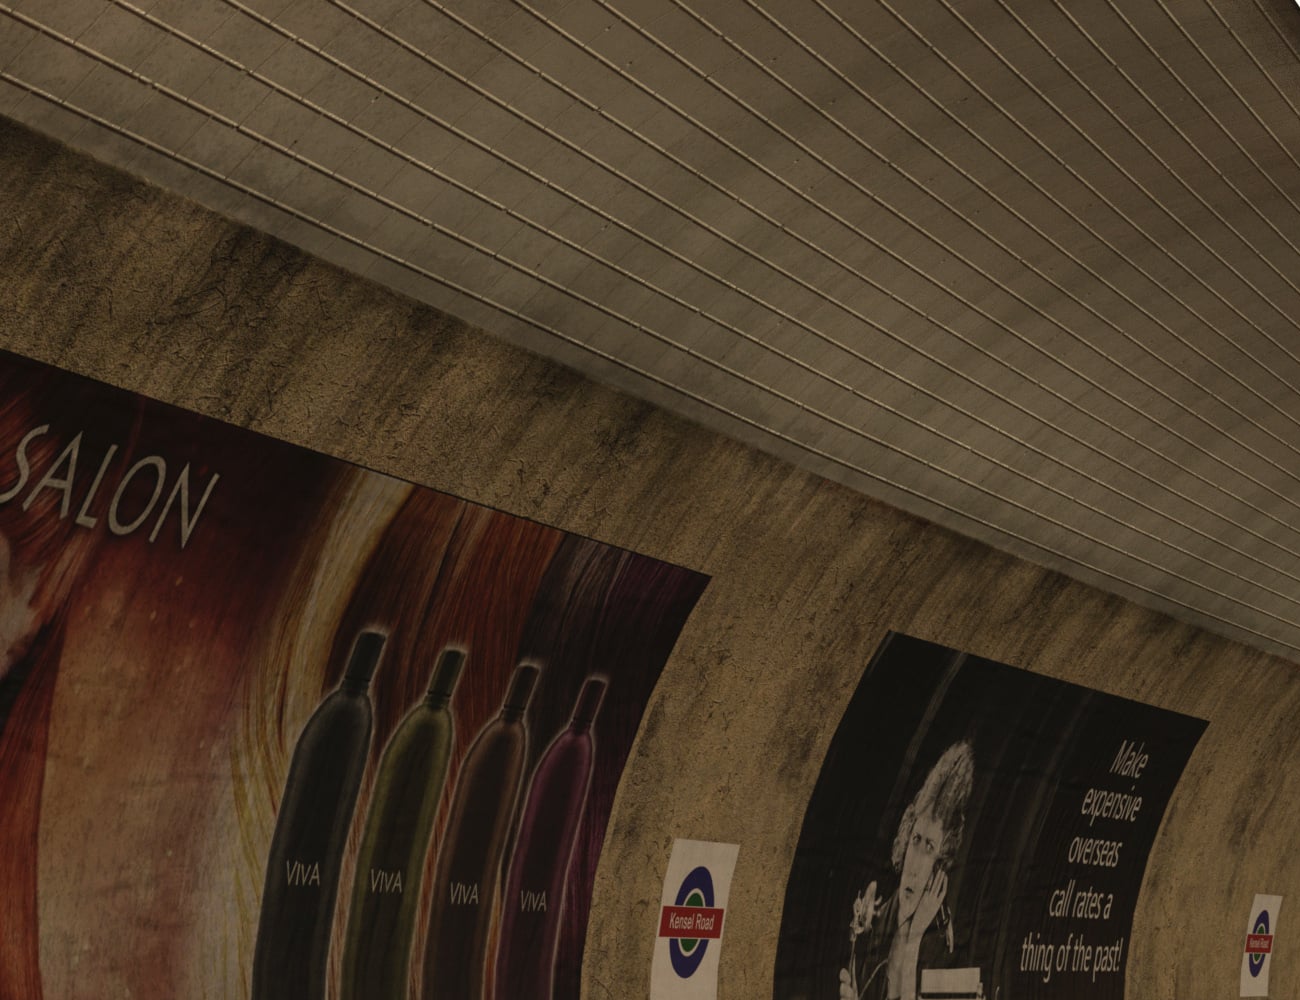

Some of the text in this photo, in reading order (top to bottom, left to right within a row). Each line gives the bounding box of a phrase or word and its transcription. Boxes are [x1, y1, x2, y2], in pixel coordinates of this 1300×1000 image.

[0, 424, 220, 550] SALON
[1109, 739, 1149, 779] Make
[1080, 785, 1142, 827] expensive
[1067, 835, 1123, 868] overseas
[286, 859, 321, 886] VIVA
[370, 868, 403, 893] VIVA
[450, 881, 480, 905] VIVA
[520, 888, 548, 912] VIVA
[1049, 879, 1113, 920] call rates a
[669, 912, 715, 931] Kensel Road
[1020, 931, 1124, 984] thing of the past!
